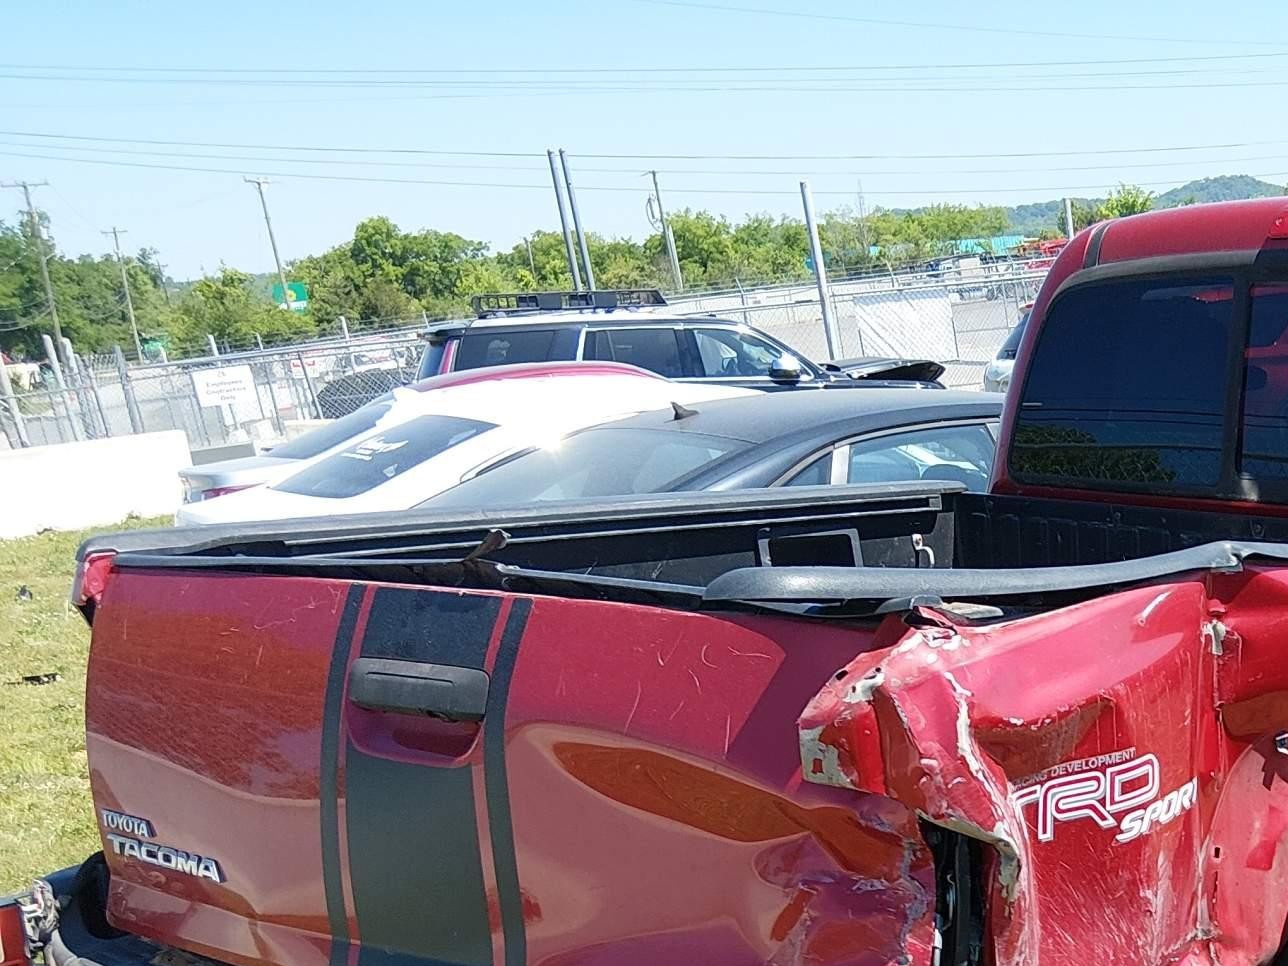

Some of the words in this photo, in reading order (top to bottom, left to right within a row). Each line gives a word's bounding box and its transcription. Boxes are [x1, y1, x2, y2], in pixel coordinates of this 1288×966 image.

[1051, 747, 1136, 777] DEVELOPMENT
[1012, 753, 1160, 843] TRD
[101, 809, 153, 838] TOYOTA
[106, 832, 223, 883] TACOMA
